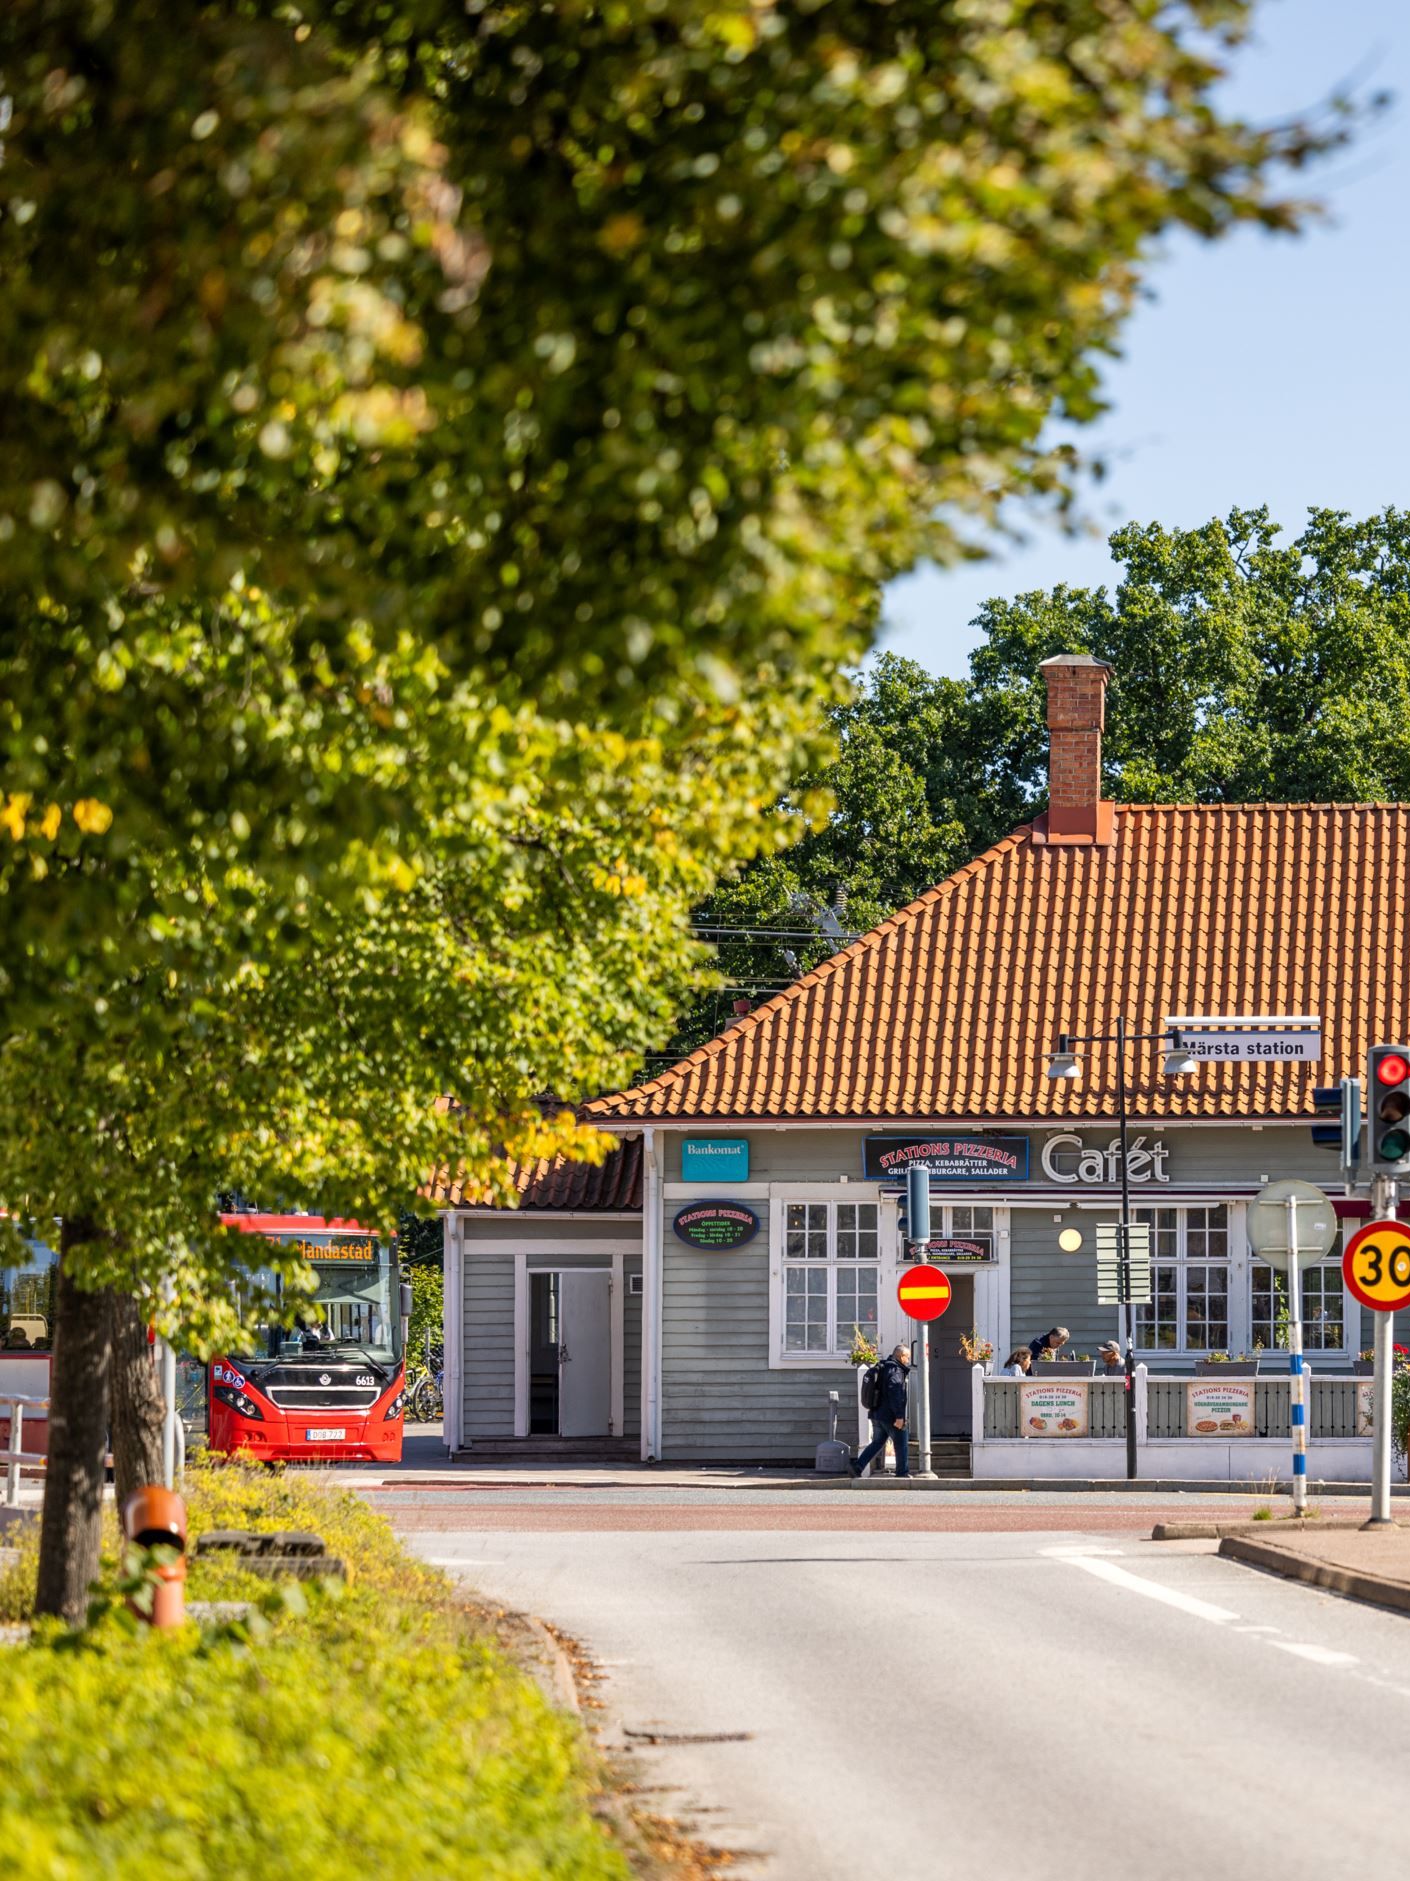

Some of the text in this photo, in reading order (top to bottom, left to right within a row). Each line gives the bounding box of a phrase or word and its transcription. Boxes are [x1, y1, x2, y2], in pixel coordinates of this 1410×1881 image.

[1183, 1041, 1304, 1055] Märsta station
[688, 1144, 741, 1155] Bankomat
[880, 1143, 1017, 1169] STATIONS PIZZERIA
[1041, 1134, 1170, 1183] Cafét
[908, 1158, 988, 1167] PIZZA, KEBABRÄTTER
[888, 1168, 910, 1176] GRILL
[928, 1168, 969, 1176] BURGARE,
[296, 1239, 373, 1260] landastad
[355, 1375, 375, 1386] 6613
[1025, 1388, 1082, 1399] STATIONS PIZZERIA
[1192, 1387, 1249, 1398] STATIONS PIZZERIA
